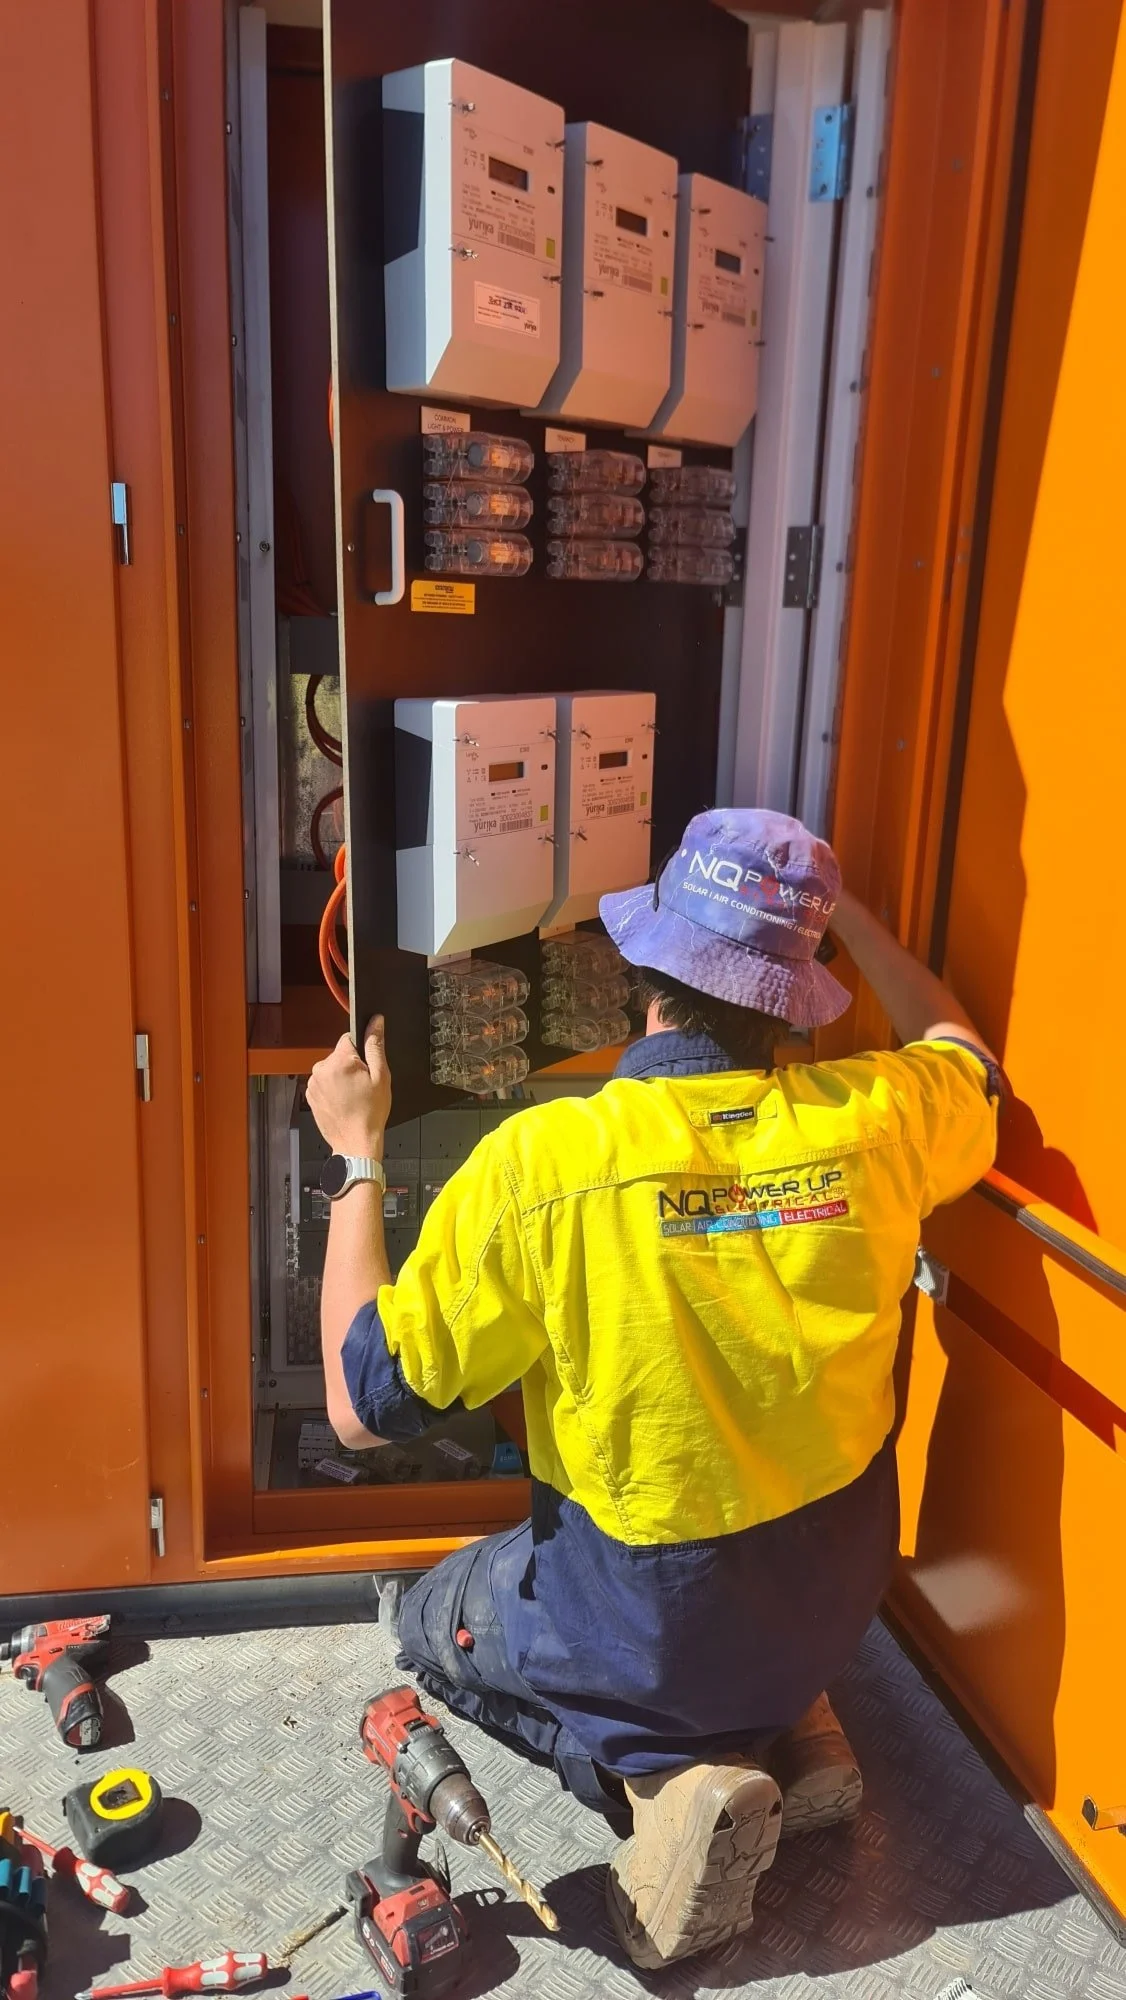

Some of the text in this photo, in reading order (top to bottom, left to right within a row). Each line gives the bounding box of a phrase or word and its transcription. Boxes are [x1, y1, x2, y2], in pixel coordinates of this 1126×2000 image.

[688, 850, 743, 892] NQ
[744, 870, 822, 912] POWER
[682, 881, 708, 897] SOLAR
[713, 892, 730, 905] AIR
[730, 900, 795, 930] CONDITIONING
[657, 1170, 842, 1218] NQ POWER UP
[663, 1223, 693, 1236] SOLAR
[784, 1203, 848, 1222] ELECTRICAL
